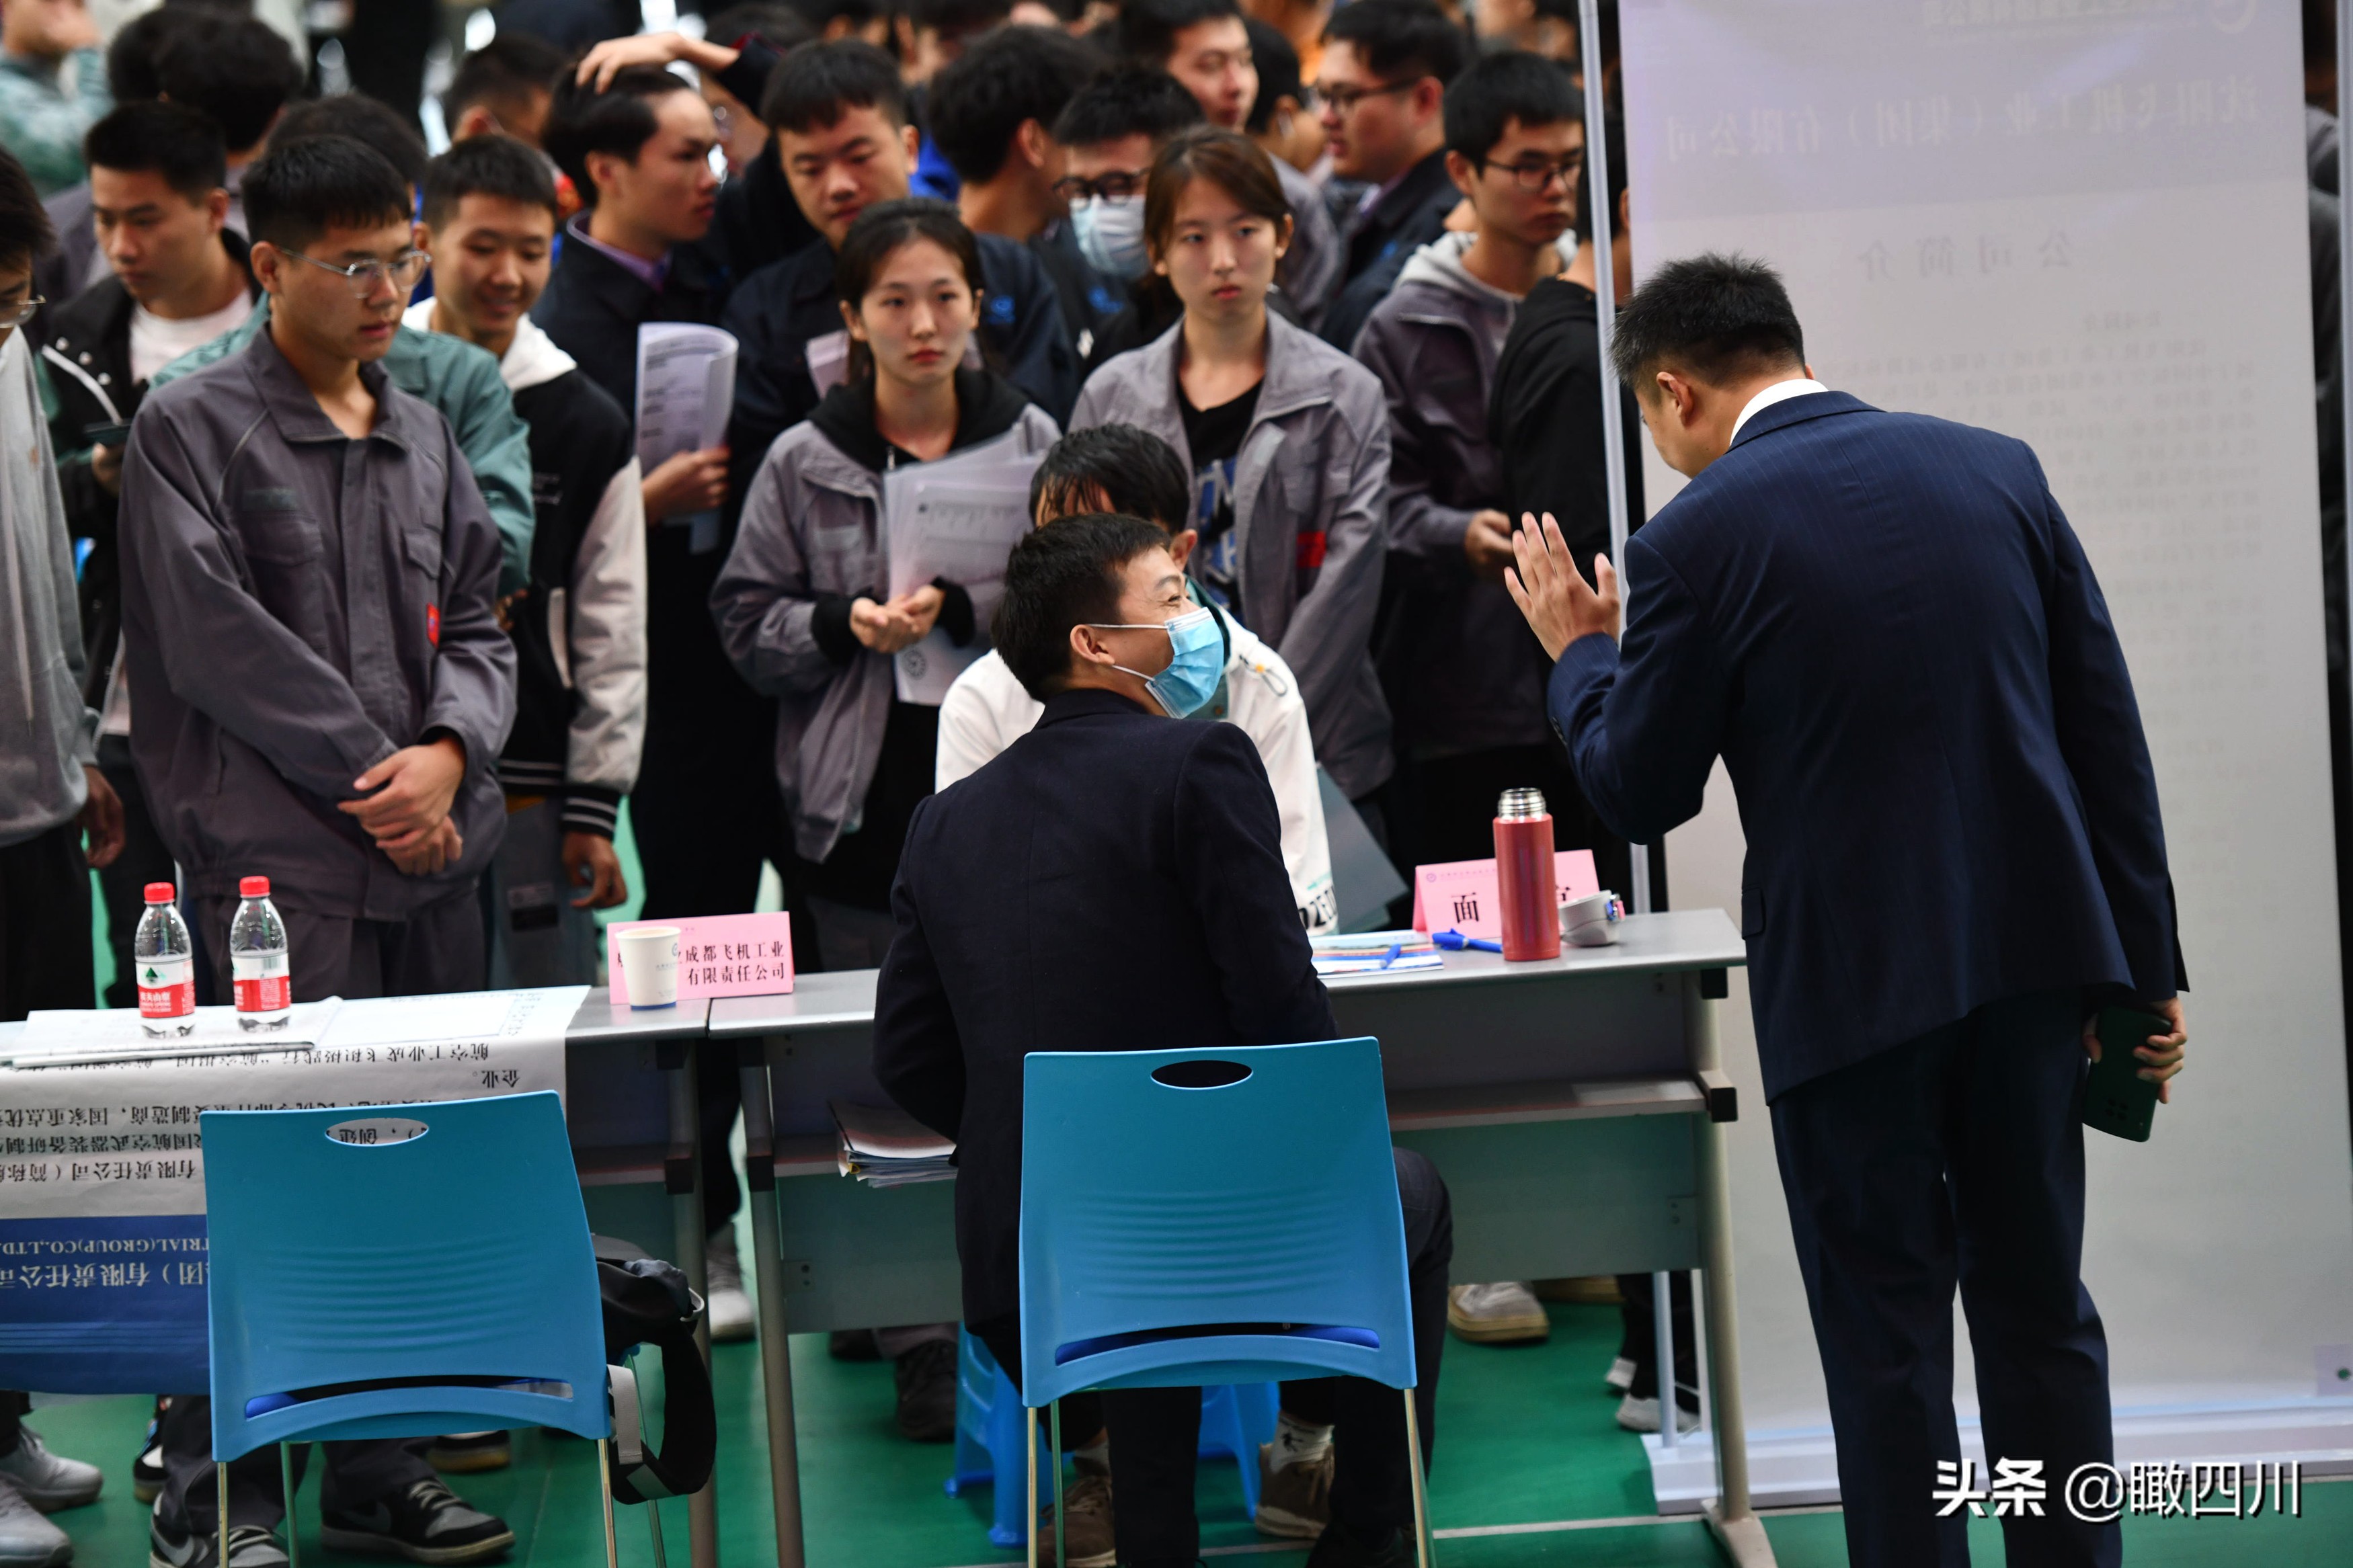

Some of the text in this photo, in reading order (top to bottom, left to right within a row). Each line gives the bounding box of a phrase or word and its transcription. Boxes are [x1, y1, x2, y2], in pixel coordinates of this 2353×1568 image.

[688, 962, 785, 986] 有限责任公司
[0, 1133, 202, 1155] 国航空武器装备研制
[0, 1262, 208, 1289] 团）有限责任公司
